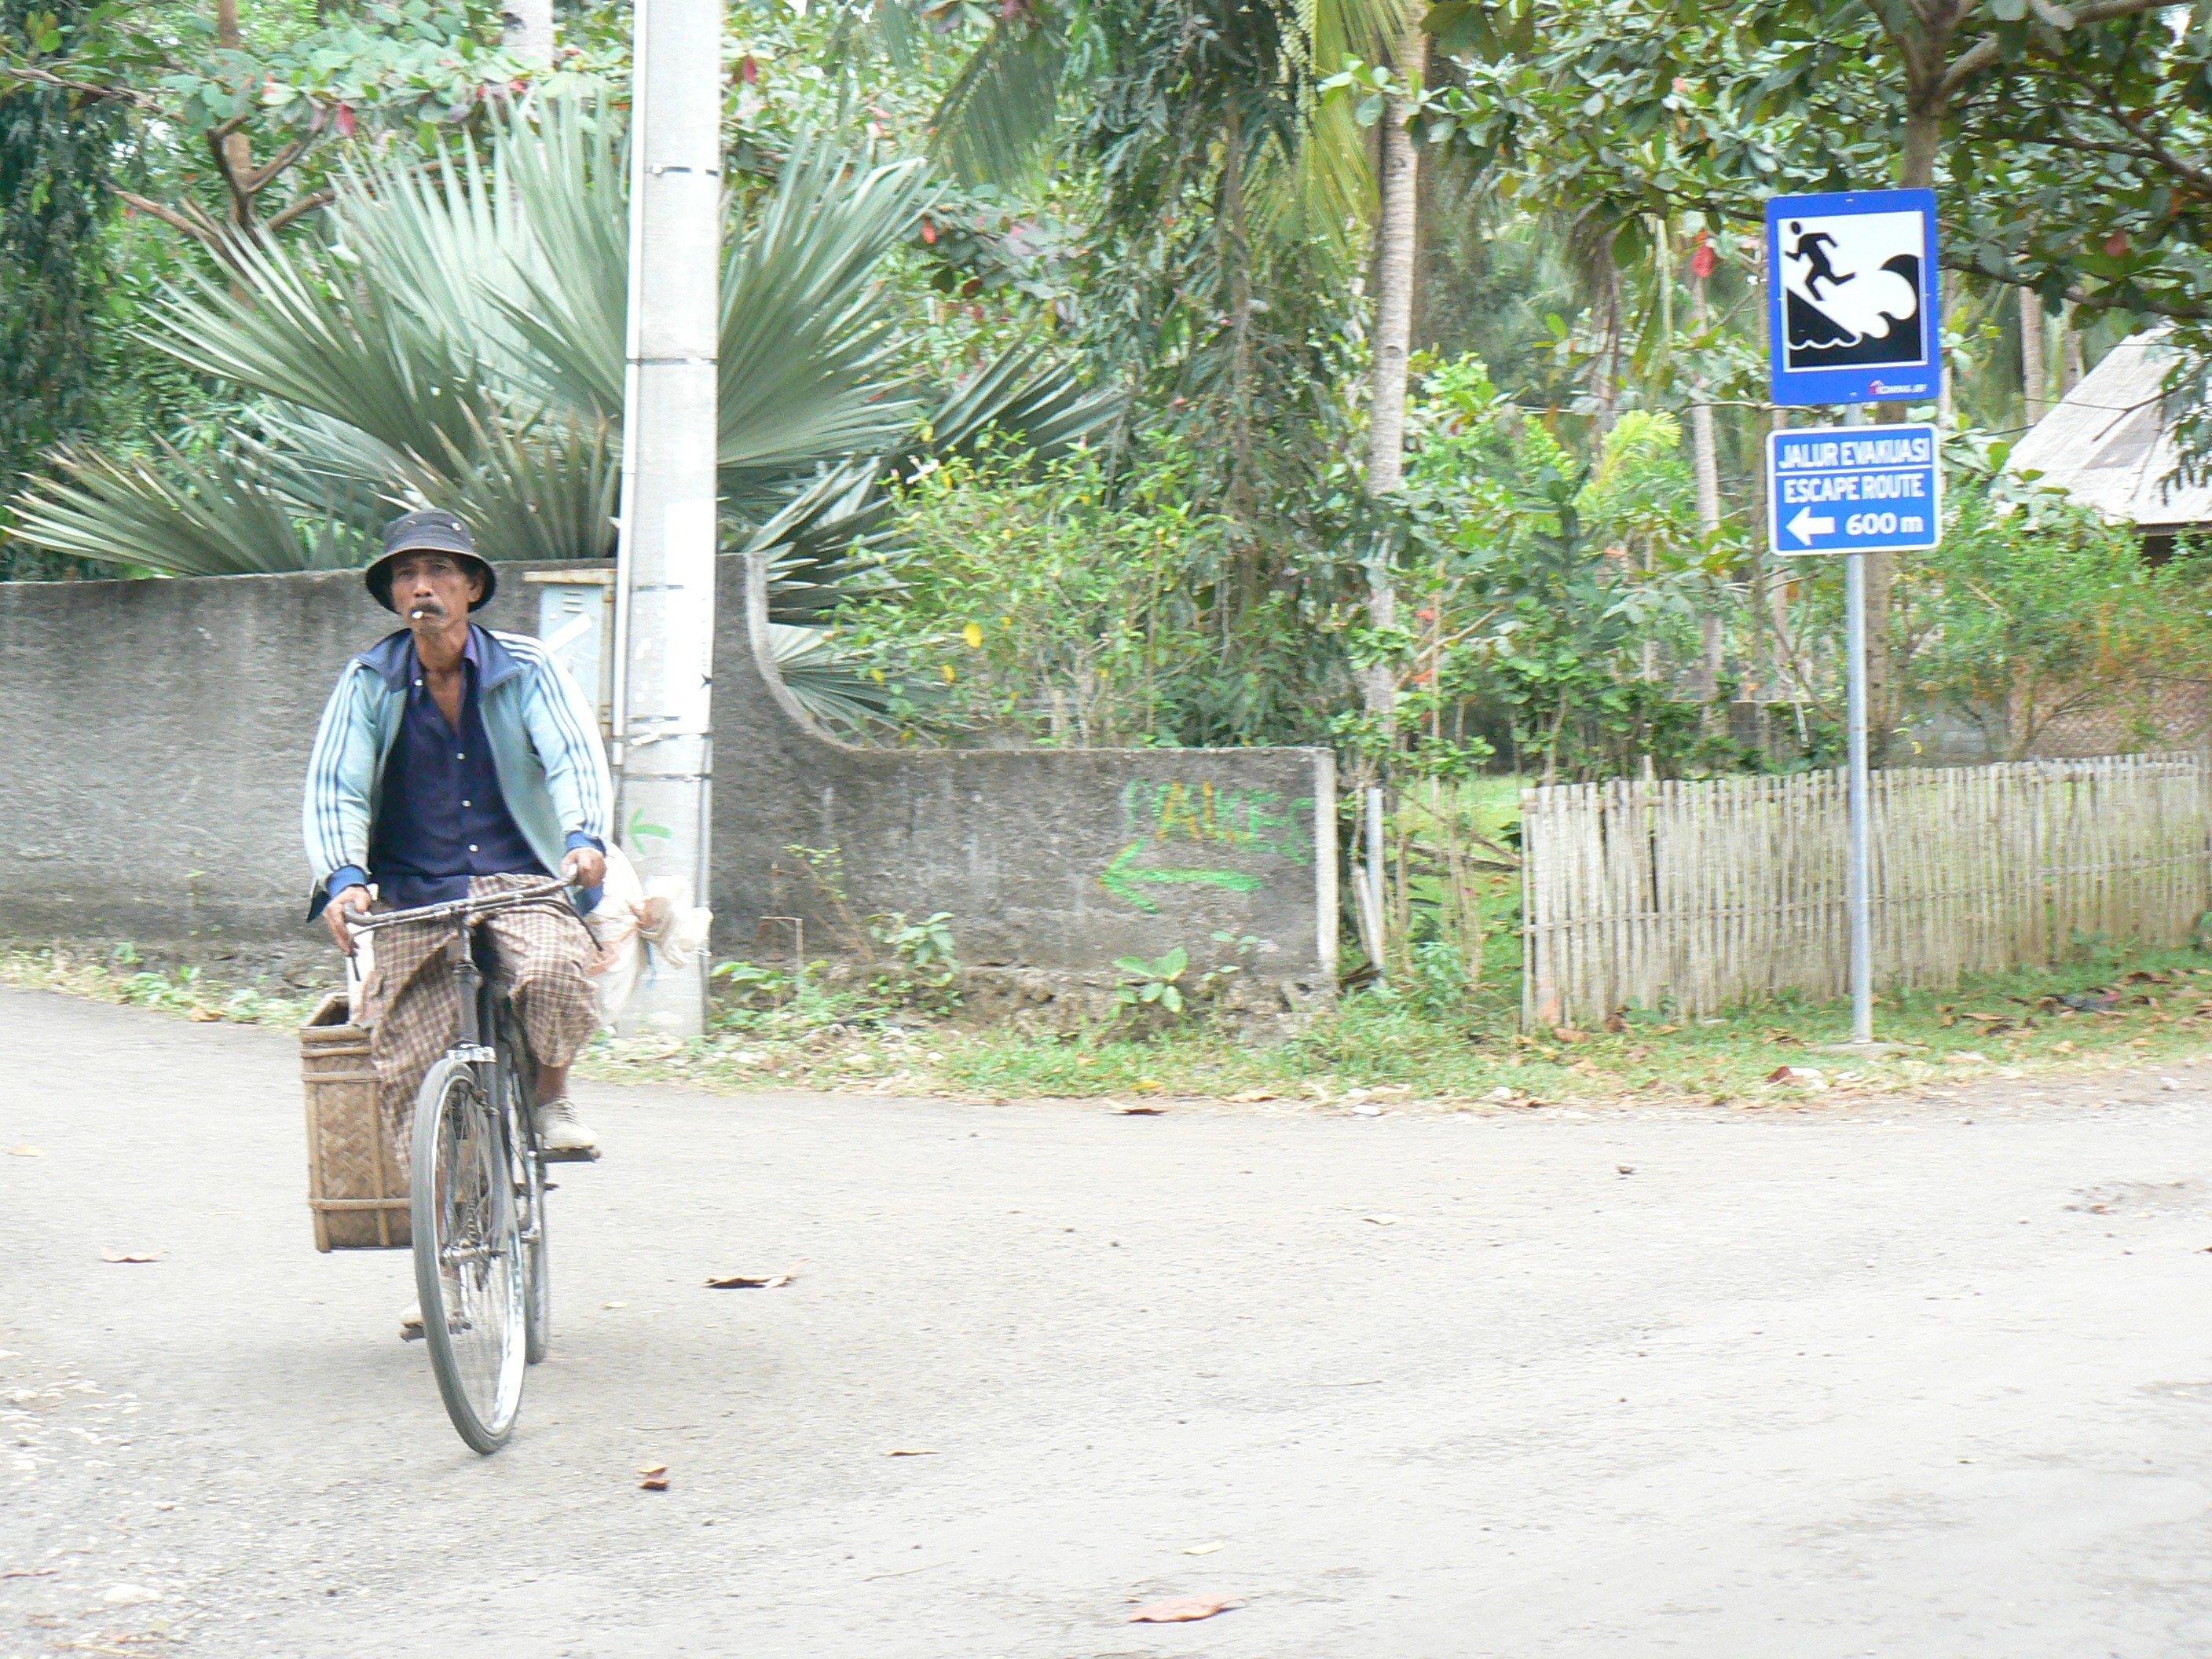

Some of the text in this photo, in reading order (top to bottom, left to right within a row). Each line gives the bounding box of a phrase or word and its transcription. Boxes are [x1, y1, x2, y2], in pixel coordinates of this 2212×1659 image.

[1778, 438, 1931, 469] JALUR EVAKUASI
[1783, 473, 1925, 504] ESCAPE ROUTE
[1846, 512, 1925, 536] 600 m
